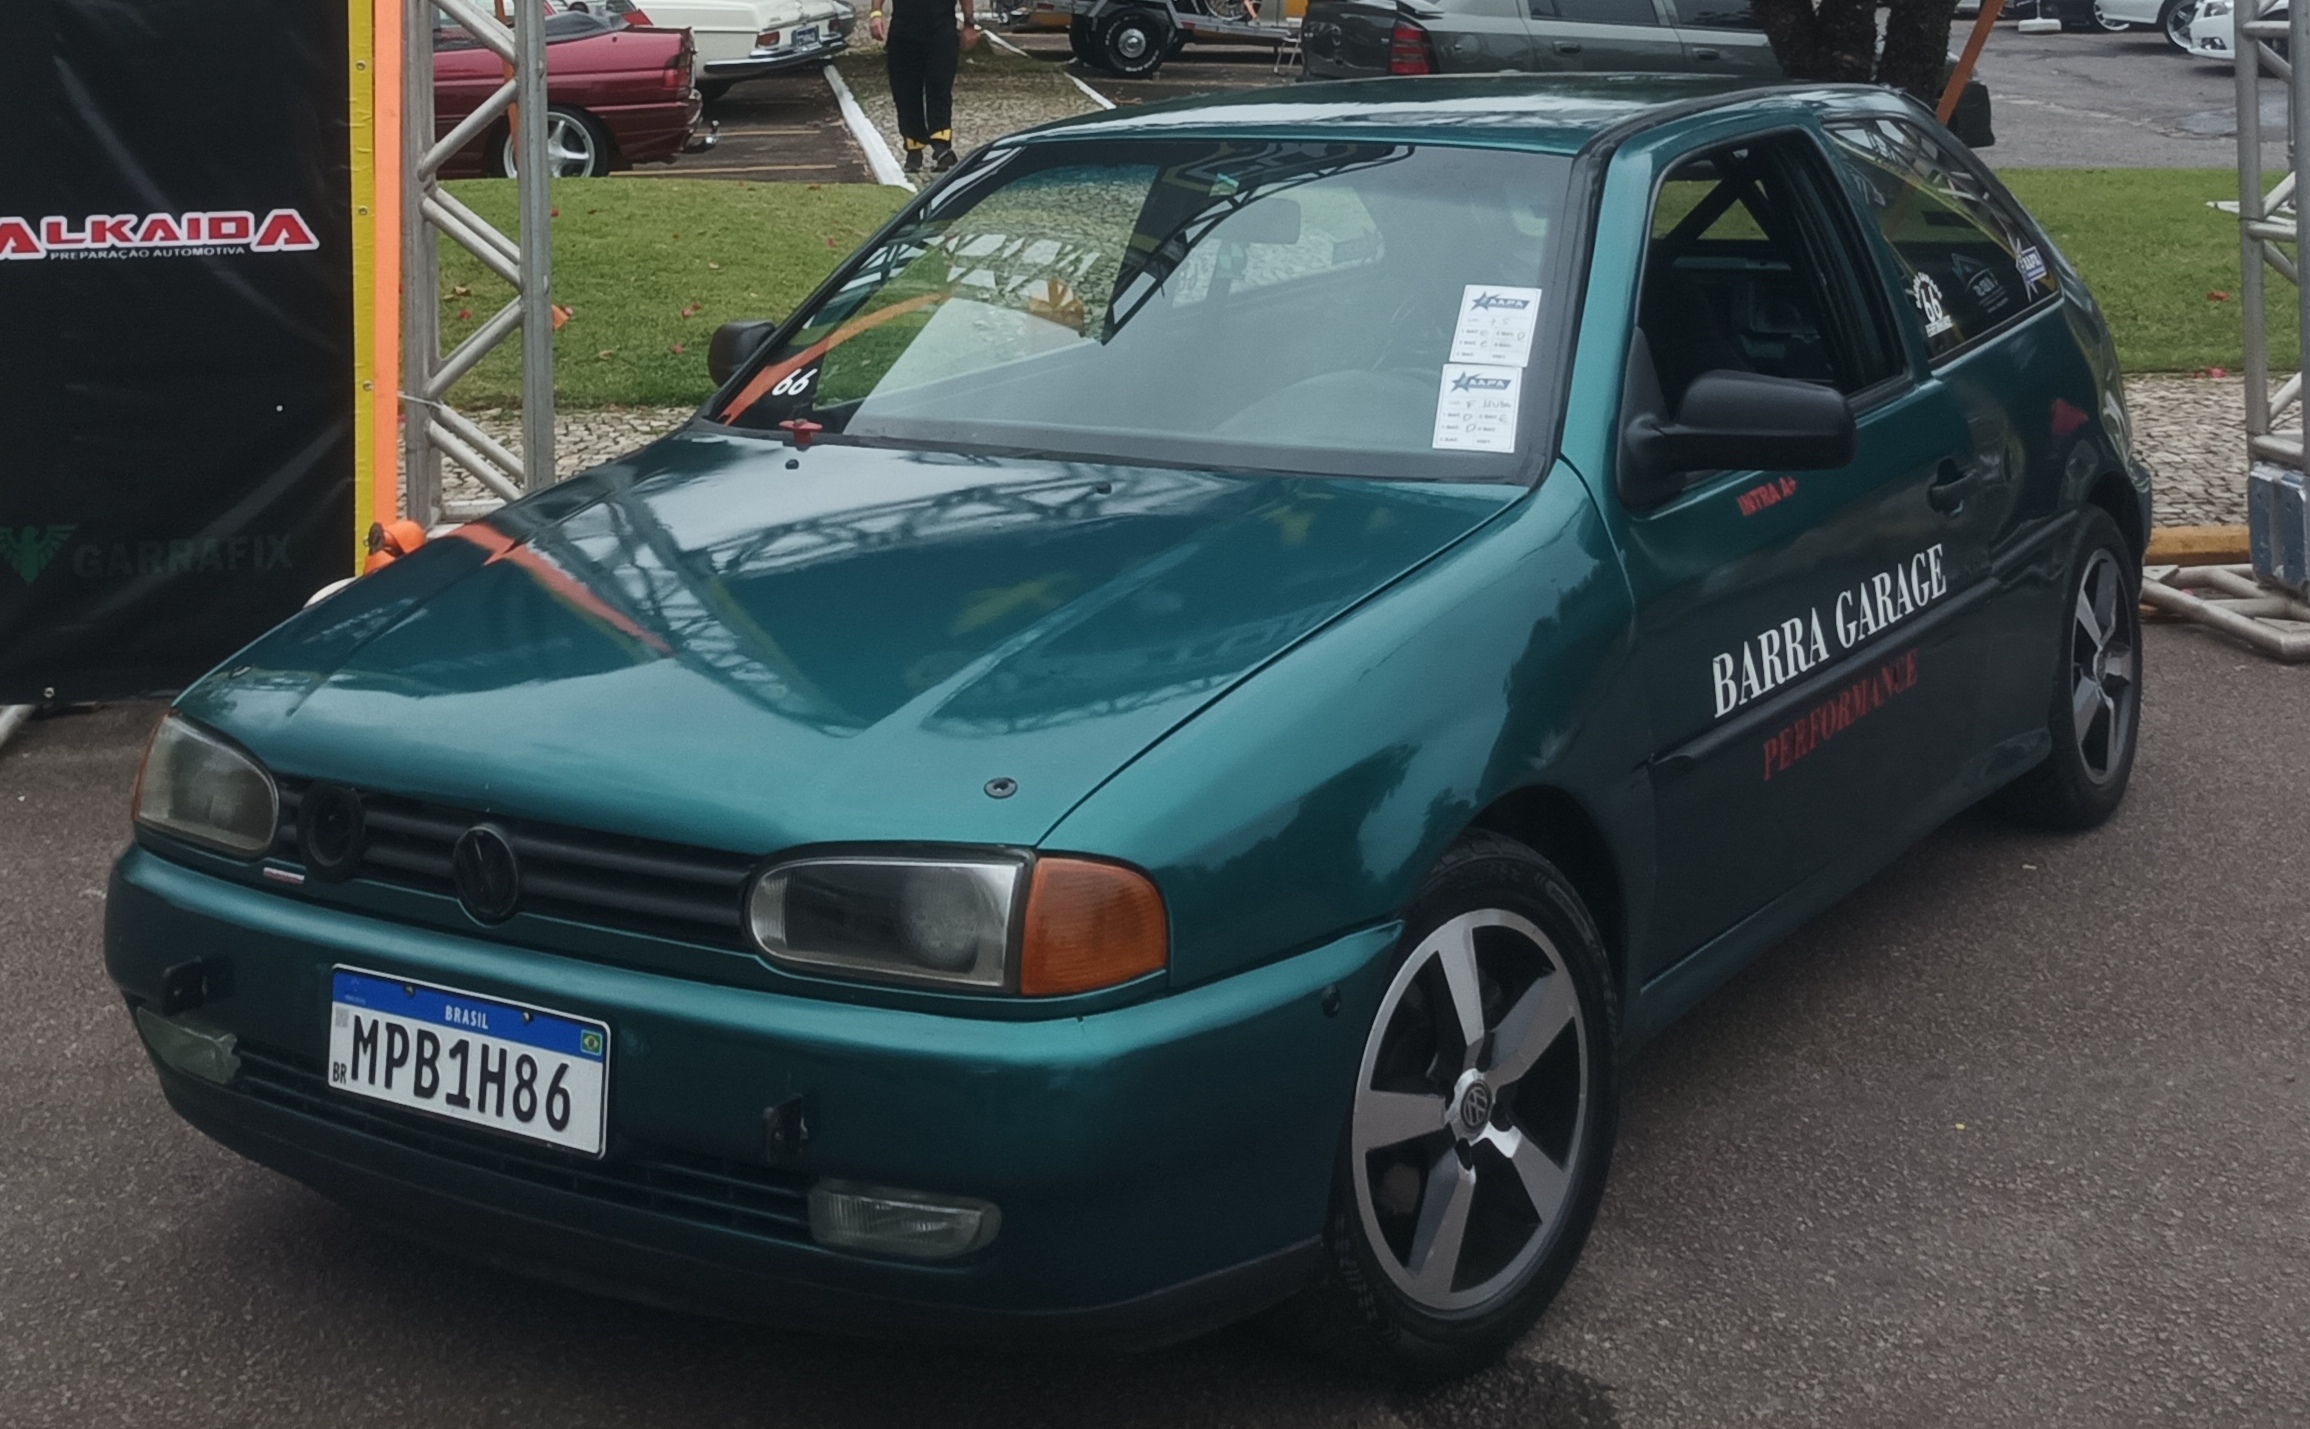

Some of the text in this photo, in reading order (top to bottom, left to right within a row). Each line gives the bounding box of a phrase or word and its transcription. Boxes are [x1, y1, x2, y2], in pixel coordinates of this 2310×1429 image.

[0, 209, 319, 260] ALKAIDA
[50, 246, 245, 260] PREPARAÇÃO AUTOMOTIVA
[1920, 286, 1943, 323] 66
[771, 368, 818, 396] 66
[71, 532, 294, 579] GARRAFIX
[1712, 543, 1947, 718] BARRA GARAGE
[444, 1004, 489, 1030] BRASIL
[332, 1061, 348, 1085] BR
[350, 1014, 571, 1132] MPB1H86
